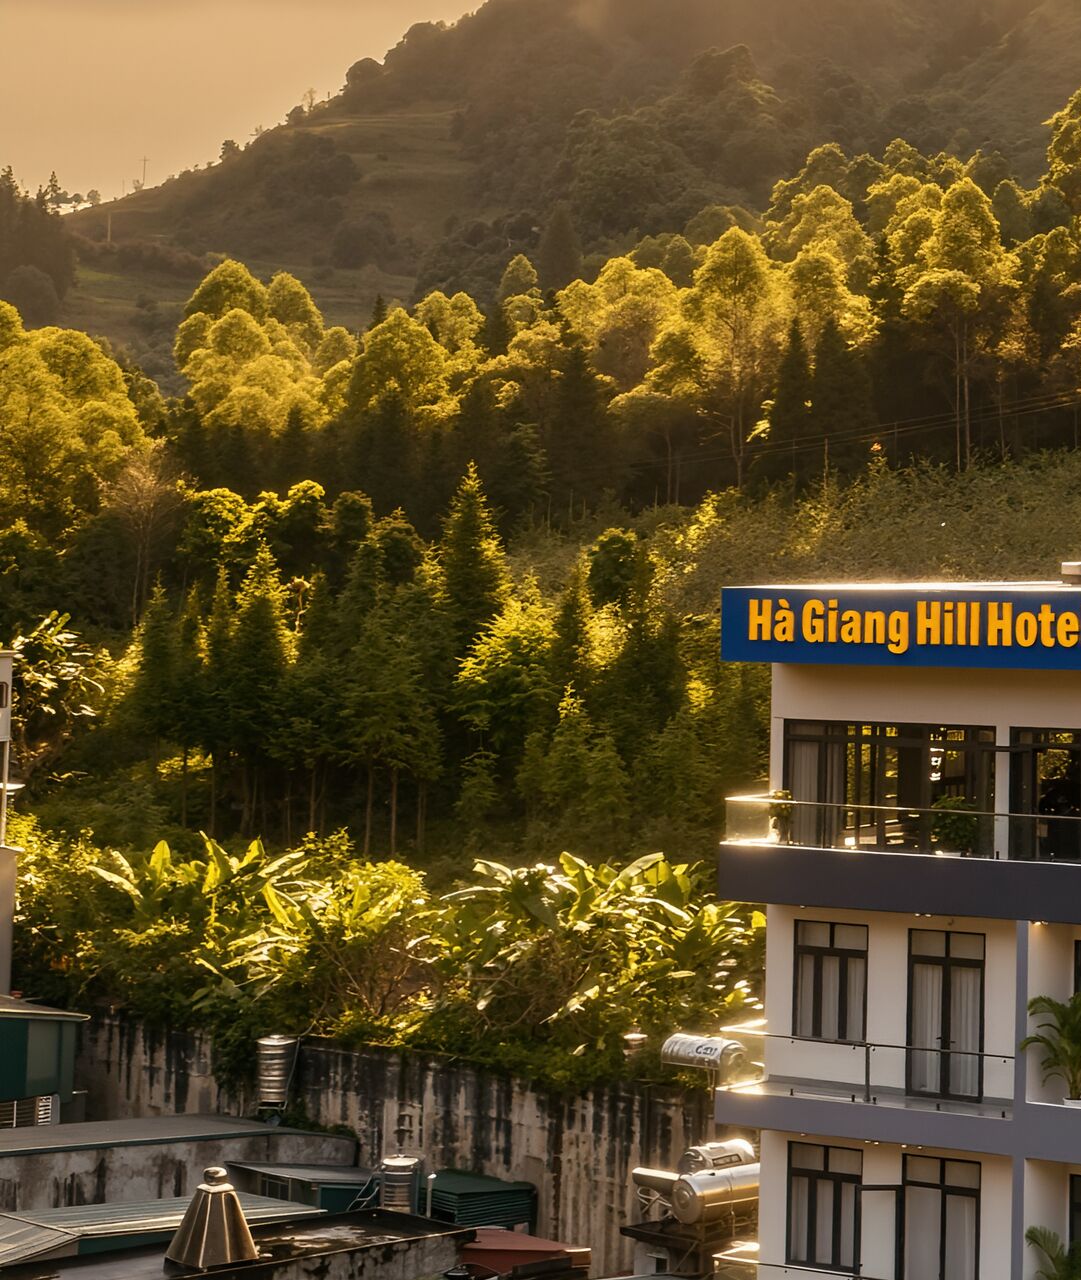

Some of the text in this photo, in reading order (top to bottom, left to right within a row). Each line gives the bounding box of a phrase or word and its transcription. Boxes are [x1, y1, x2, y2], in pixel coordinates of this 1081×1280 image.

[748, 598, 796, 642] Hà
[801, 599, 910, 654] Giang
[916, 600, 982, 647] Hill
